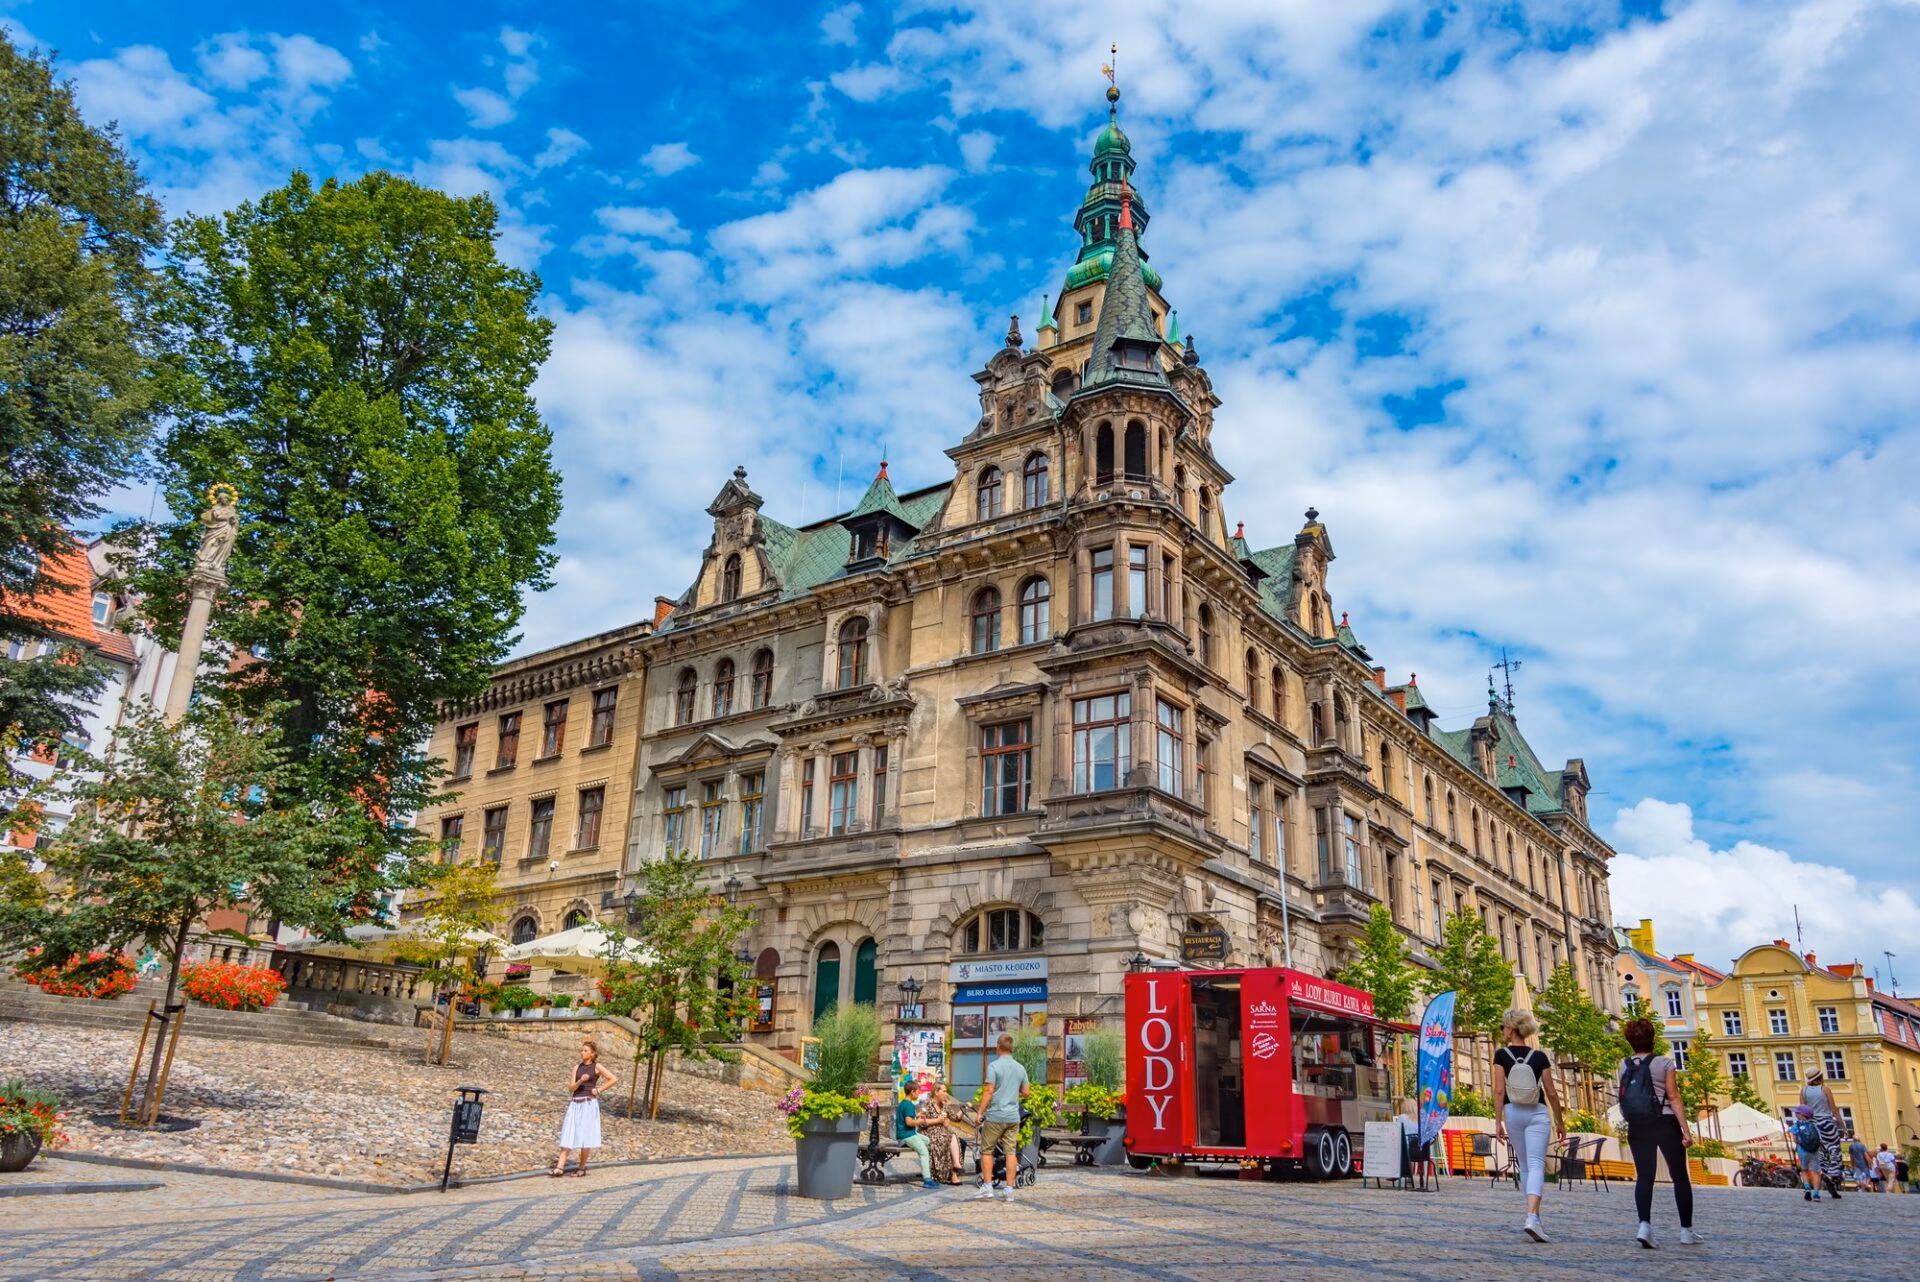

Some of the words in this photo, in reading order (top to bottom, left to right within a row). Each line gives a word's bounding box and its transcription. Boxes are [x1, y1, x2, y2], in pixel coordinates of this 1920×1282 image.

[1185, 936, 1222, 945] RESTAURACJA
[975, 964, 1003, 973] MIASTO
[1005, 962, 1040, 971] KŁODZKO
[966, 989, 985, 997] BIURO
[985, 987, 1011, 996] OBSŁUGI
[1012, 985, 1042, 995] LUDNOŚCI
[1305, 983, 1323, 1001] LODY
[1323, 988, 1342, 1007] RURKI
[1343, 994, 1360, 1012] KAWA
[1141, 980, 1174, 1130] LODY
